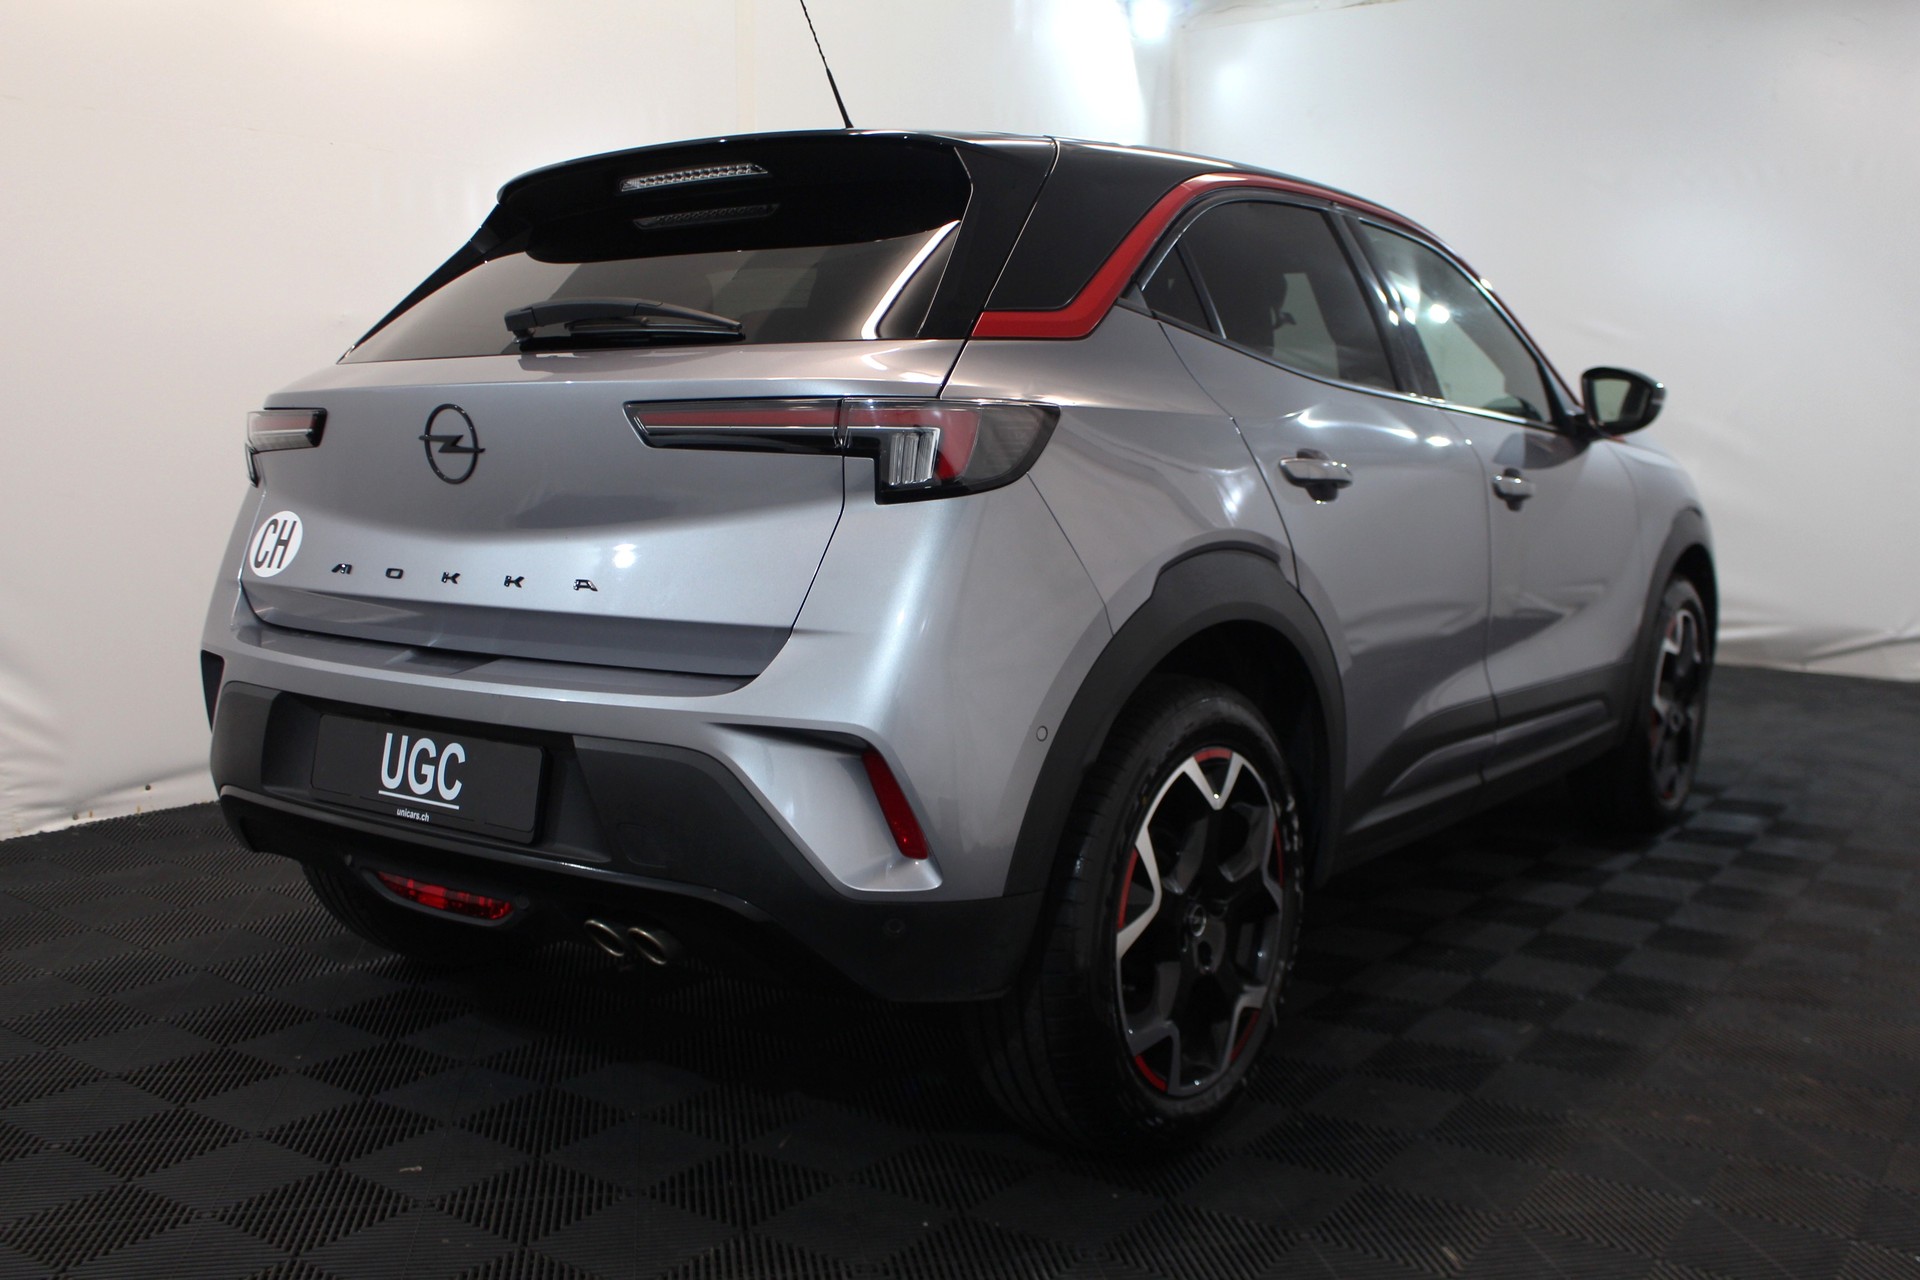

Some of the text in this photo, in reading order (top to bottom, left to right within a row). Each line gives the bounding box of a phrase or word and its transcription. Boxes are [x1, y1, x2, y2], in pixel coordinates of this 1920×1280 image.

[253, 518, 297, 570] CH
[331, 562, 598, 592] MOKKA
[380, 732, 466, 801] UGC
[396, 807, 430, 823] unicars.ch
